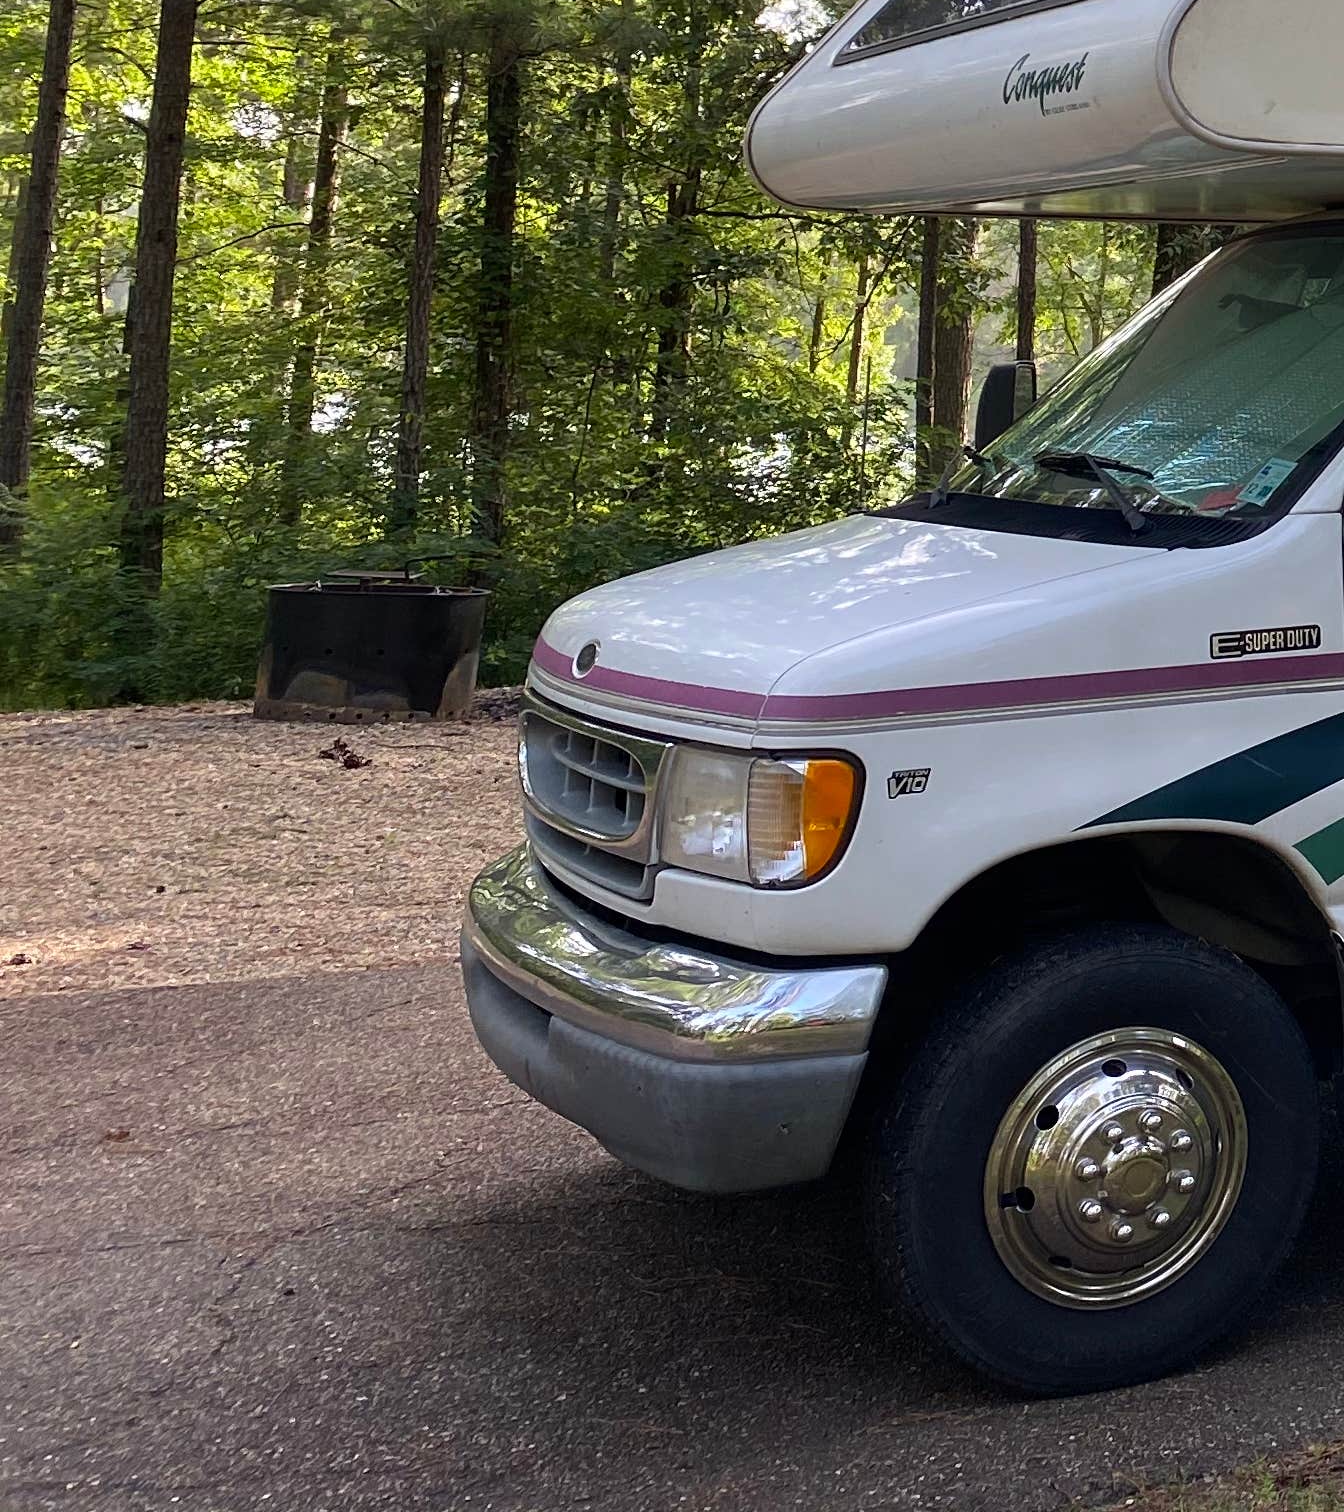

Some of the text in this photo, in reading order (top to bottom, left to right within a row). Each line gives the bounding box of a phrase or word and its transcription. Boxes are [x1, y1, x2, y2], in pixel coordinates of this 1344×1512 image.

[1003, 51, 1089, 117] Conquest
[1286, 627, 1319, 649] DUTY
[889, 776, 927, 798] V10
